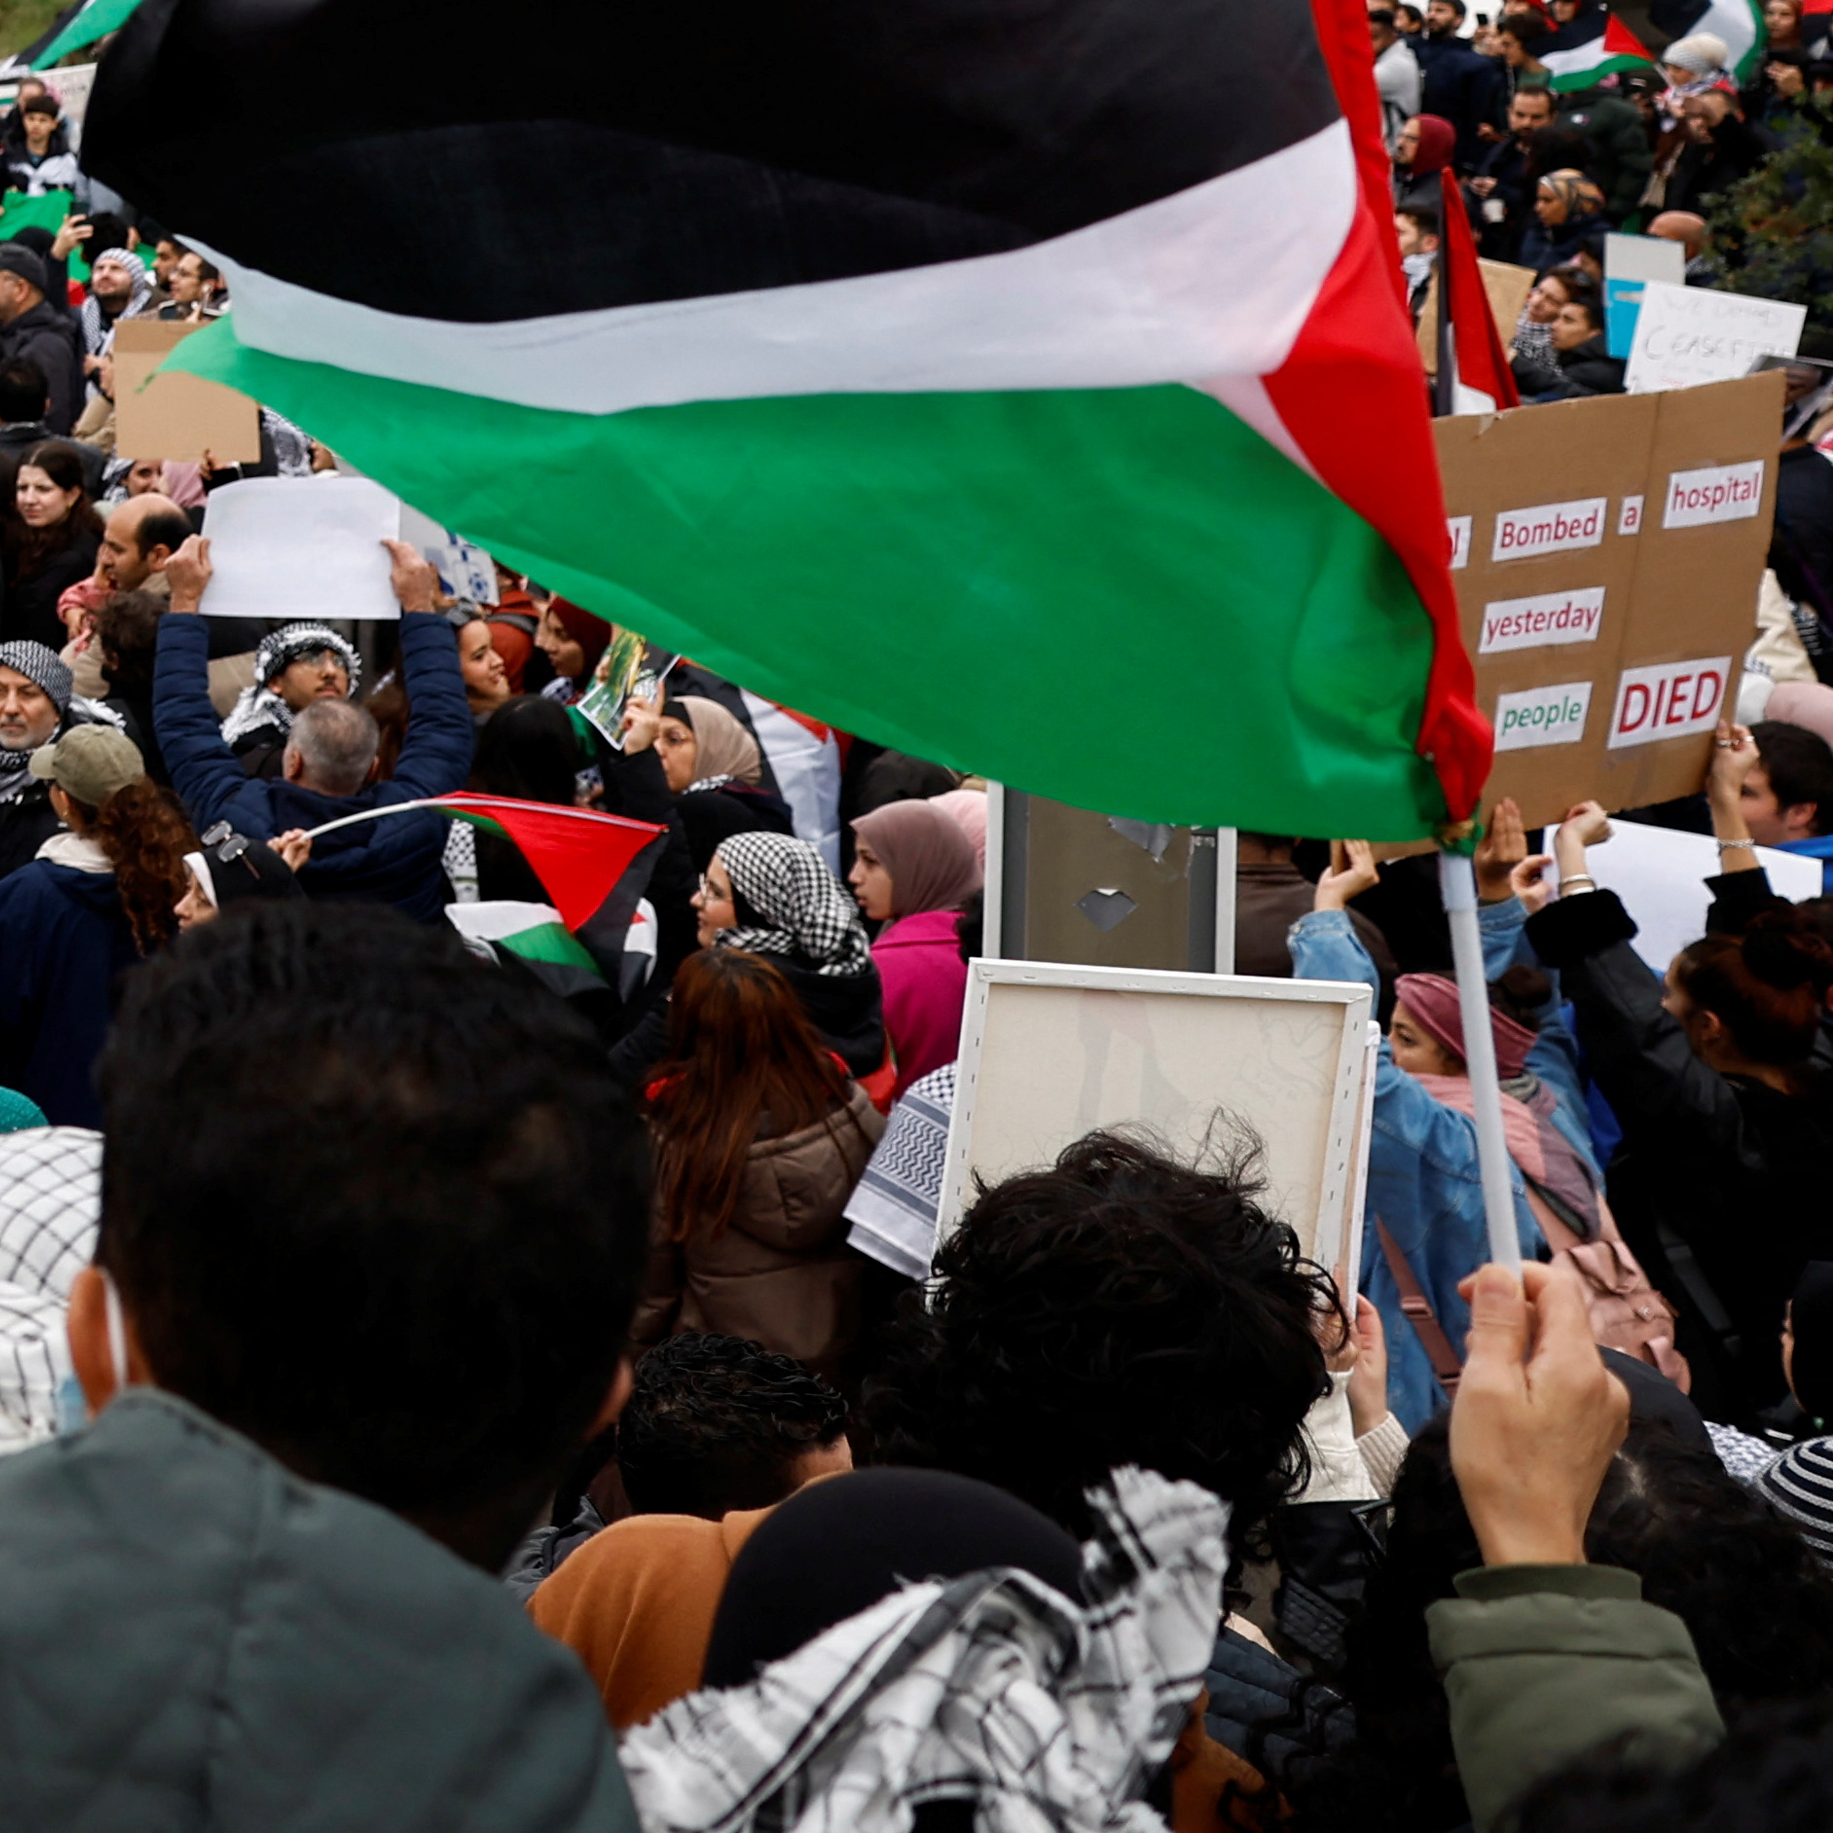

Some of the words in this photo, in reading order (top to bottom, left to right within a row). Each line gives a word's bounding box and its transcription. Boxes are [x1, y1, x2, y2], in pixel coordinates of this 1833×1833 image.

[1500, 507, 1599, 549] Bombed
[1624, 505, 1637, 527] a
[1671, 472, 1760, 513] hospital
[1486, 601, 1600, 645] yesterday
[1501, 695, 1582, 736] people
[1618, 670, 1722, 734] DIED
